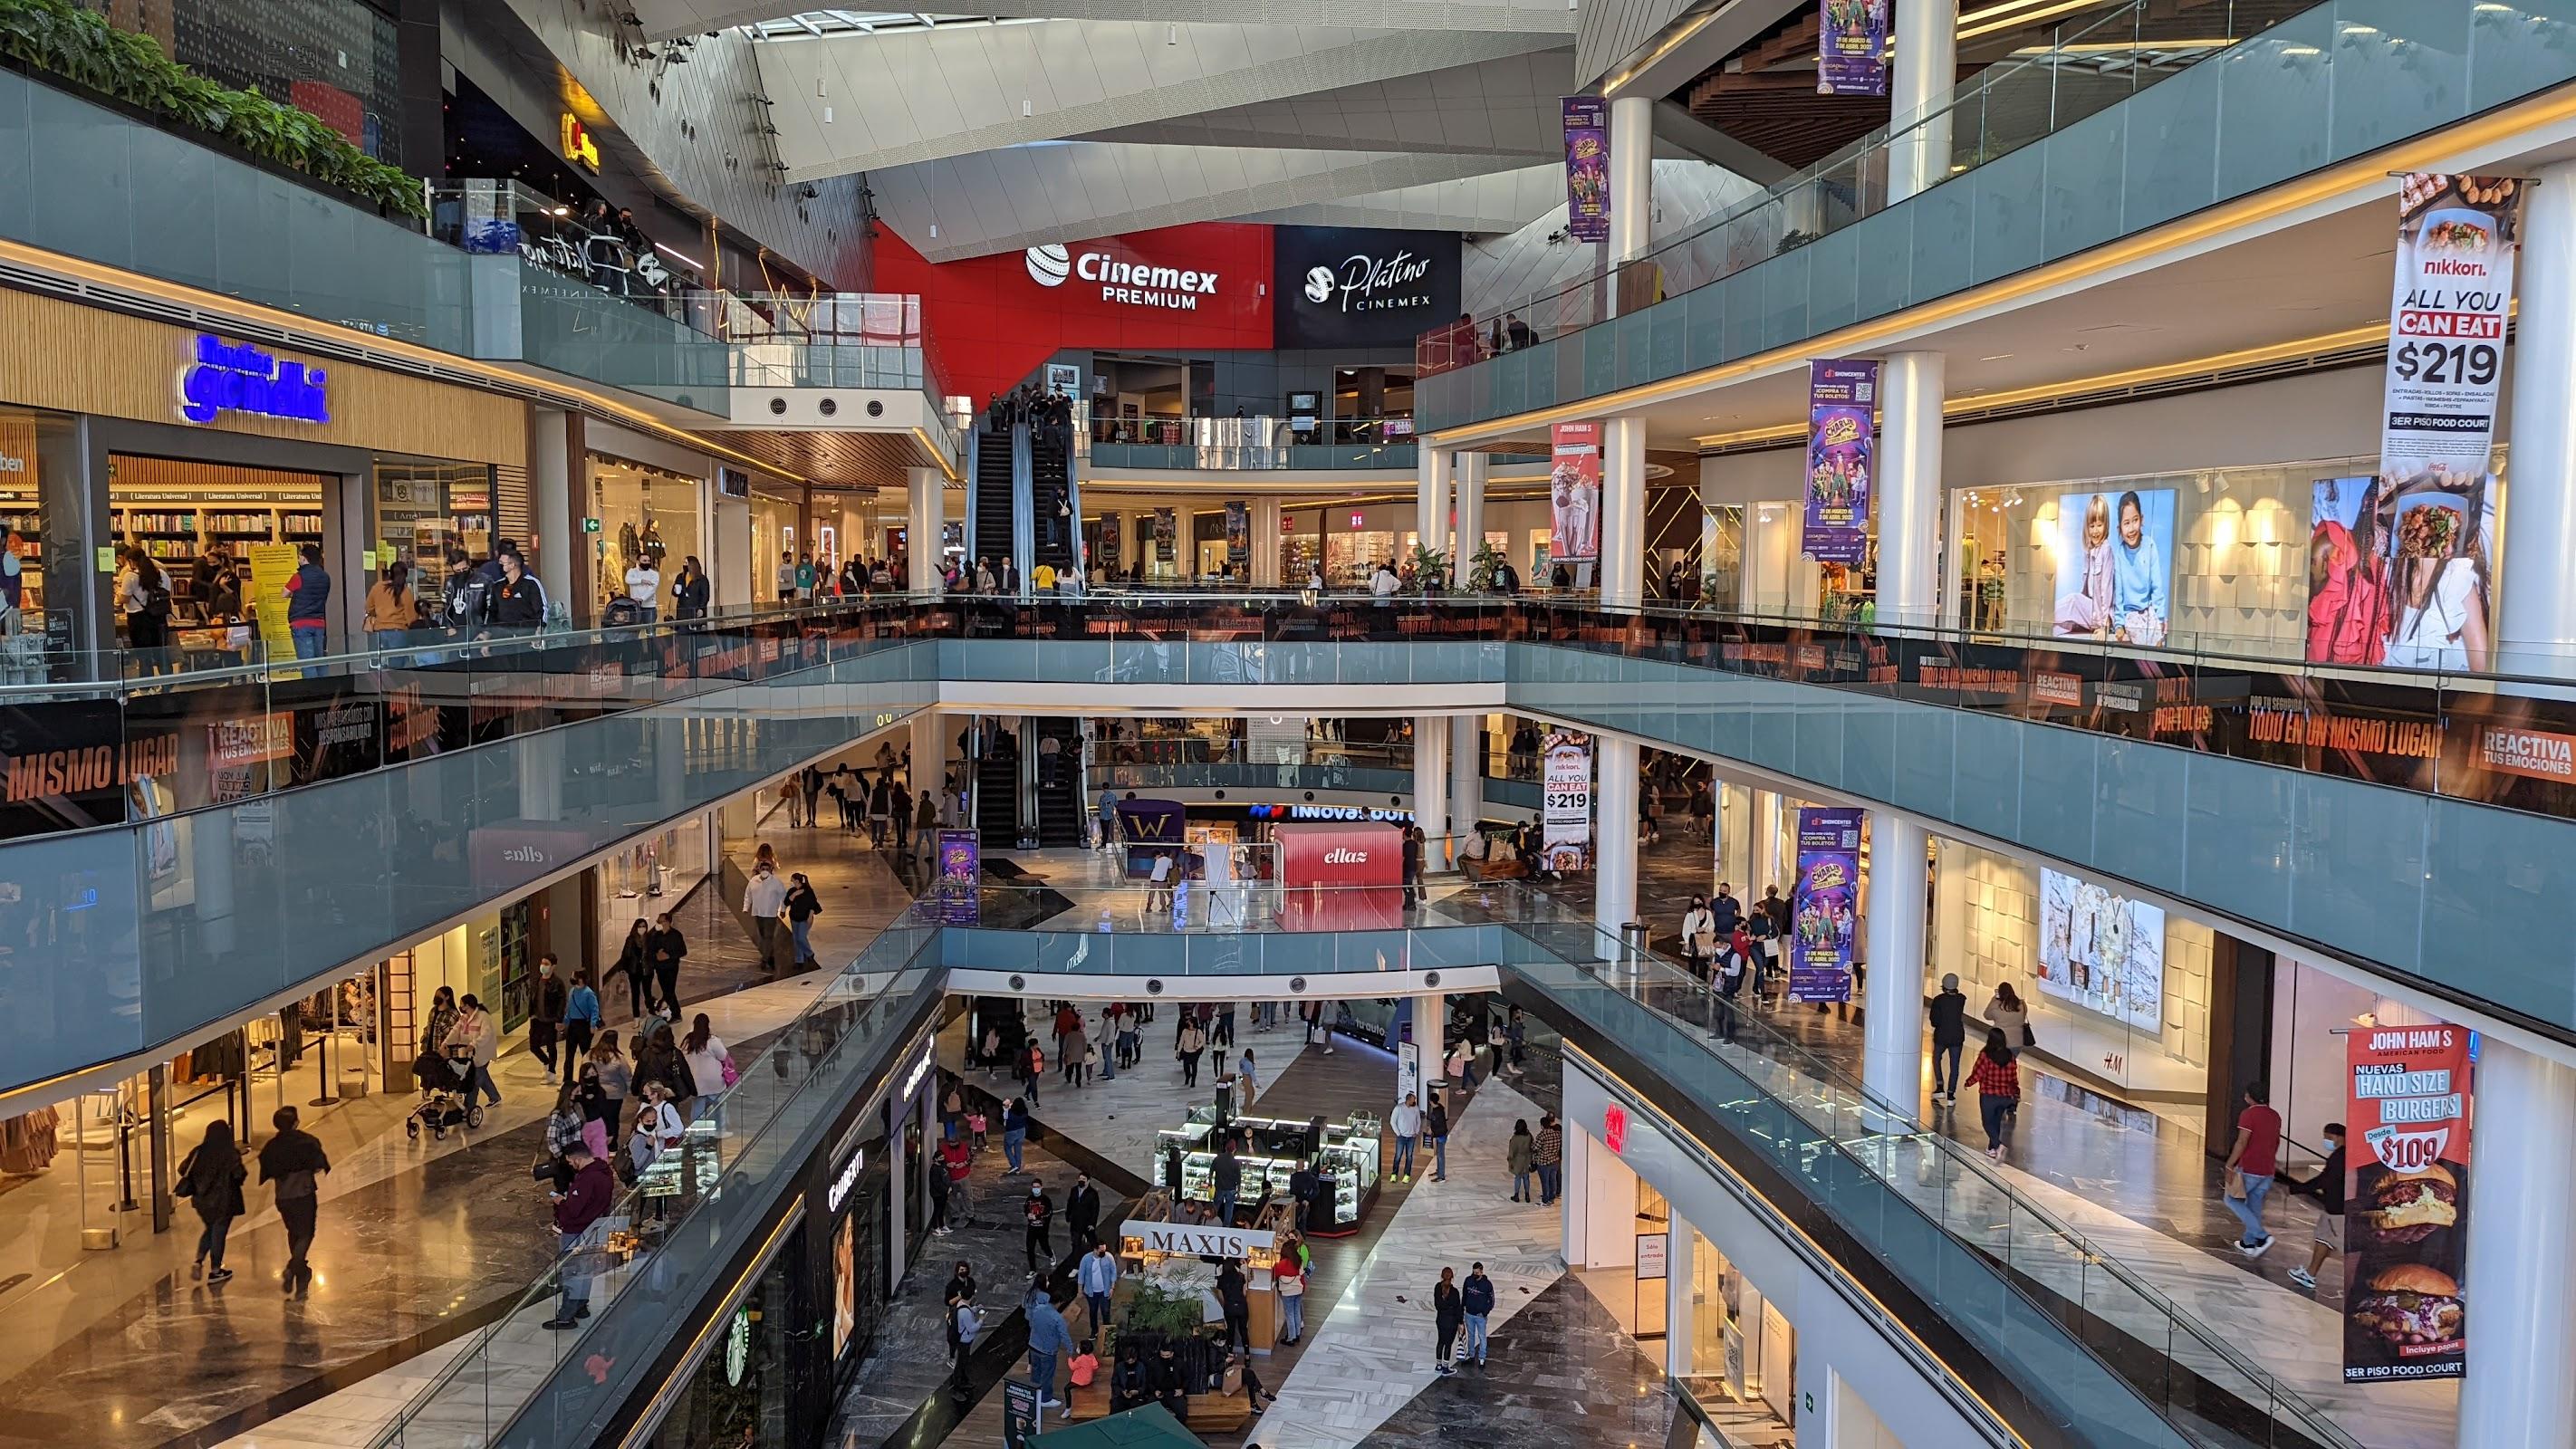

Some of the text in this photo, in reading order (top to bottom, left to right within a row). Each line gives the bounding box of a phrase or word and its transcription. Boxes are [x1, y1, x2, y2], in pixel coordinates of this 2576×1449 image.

[1077, 253, 1218, 293] Cinemex
[1341, 250, 1430, 312] Platino
[1102, 286, 1196, 310] PREMIUM
[1357, 296, 1430, 311] CINEMEX
[2402, 289, 2502, 312] ALL YOU
[2400, 313, 2500, 338] CAN EAT
[2395, 341, 2497, 385] $219
[2391, 417, 2489, 429] 3ER PISO FOOD COURT
[1168, 618, 1197, 632] LUGAR
[1346, 622, 1370, 636] TODOS
[1419, 621, 1431, 633] EN
[1869, 647, 1879, 664] POR
[1880, 665, 1898, 685] TODOS
[1919, 666, 2018, 694] TODO EN UN MISMO LUGAR
[2037, 674, 2078, 691] REACTIVA
[2037, 687, 2078, 701] TUS EMOCIONES
[2157, 677, 2190, 706] POR TI,
[2250, 696, 2263, 708] POR
[2263, 696, 2272, 710] TU
[363, 706, 375, 723] CON
[2155, 707, 2174, 732] POR
[319, 723, 371, 746] RESPONSABILIDAD
[2249, 710, 2444, 759] TODO EN UN MISMO LUGAR
[219, 737, 290, 761] TUS EMOCINES
[2485, 731, 2572, 763] REACTIVA
[7, 733, 178, 802] MISMO LUGAR
[2484, 750, 2571, 775] TUS EMOCIONES
[1547, 782, 1587, 792] CAN EAT
[1569, 774, 1587, 782] YOU
[1547, 793, 1587, 808] $219
[1324, 848, 1368, 864] ellaz
[2369, 1032, 2406, 1051] JOHN
[2104, 1051, 2123, 1075] H&M
[2377, 1050, 2419, 1058] AMERICAN
[2356, 1063, 2404, 1075] NUEVAS
[2360, 1071, 2446, 1096] HAND SIZE
[2384, 1096, 2457, 1121] BURGERS
[2368, 1128, 2391, 1140] Desde
[2382, 1136, 2438, 1168] $109
[829, 1148, 862, 1213] GHIBERTI
[1151, 1231, 1242, 1256] MAXIS
[2406, 1341, 2458, 1355] Incluye papas
[2346, 1362, 2462, 1377] 3ER PISO FOOD COURT
